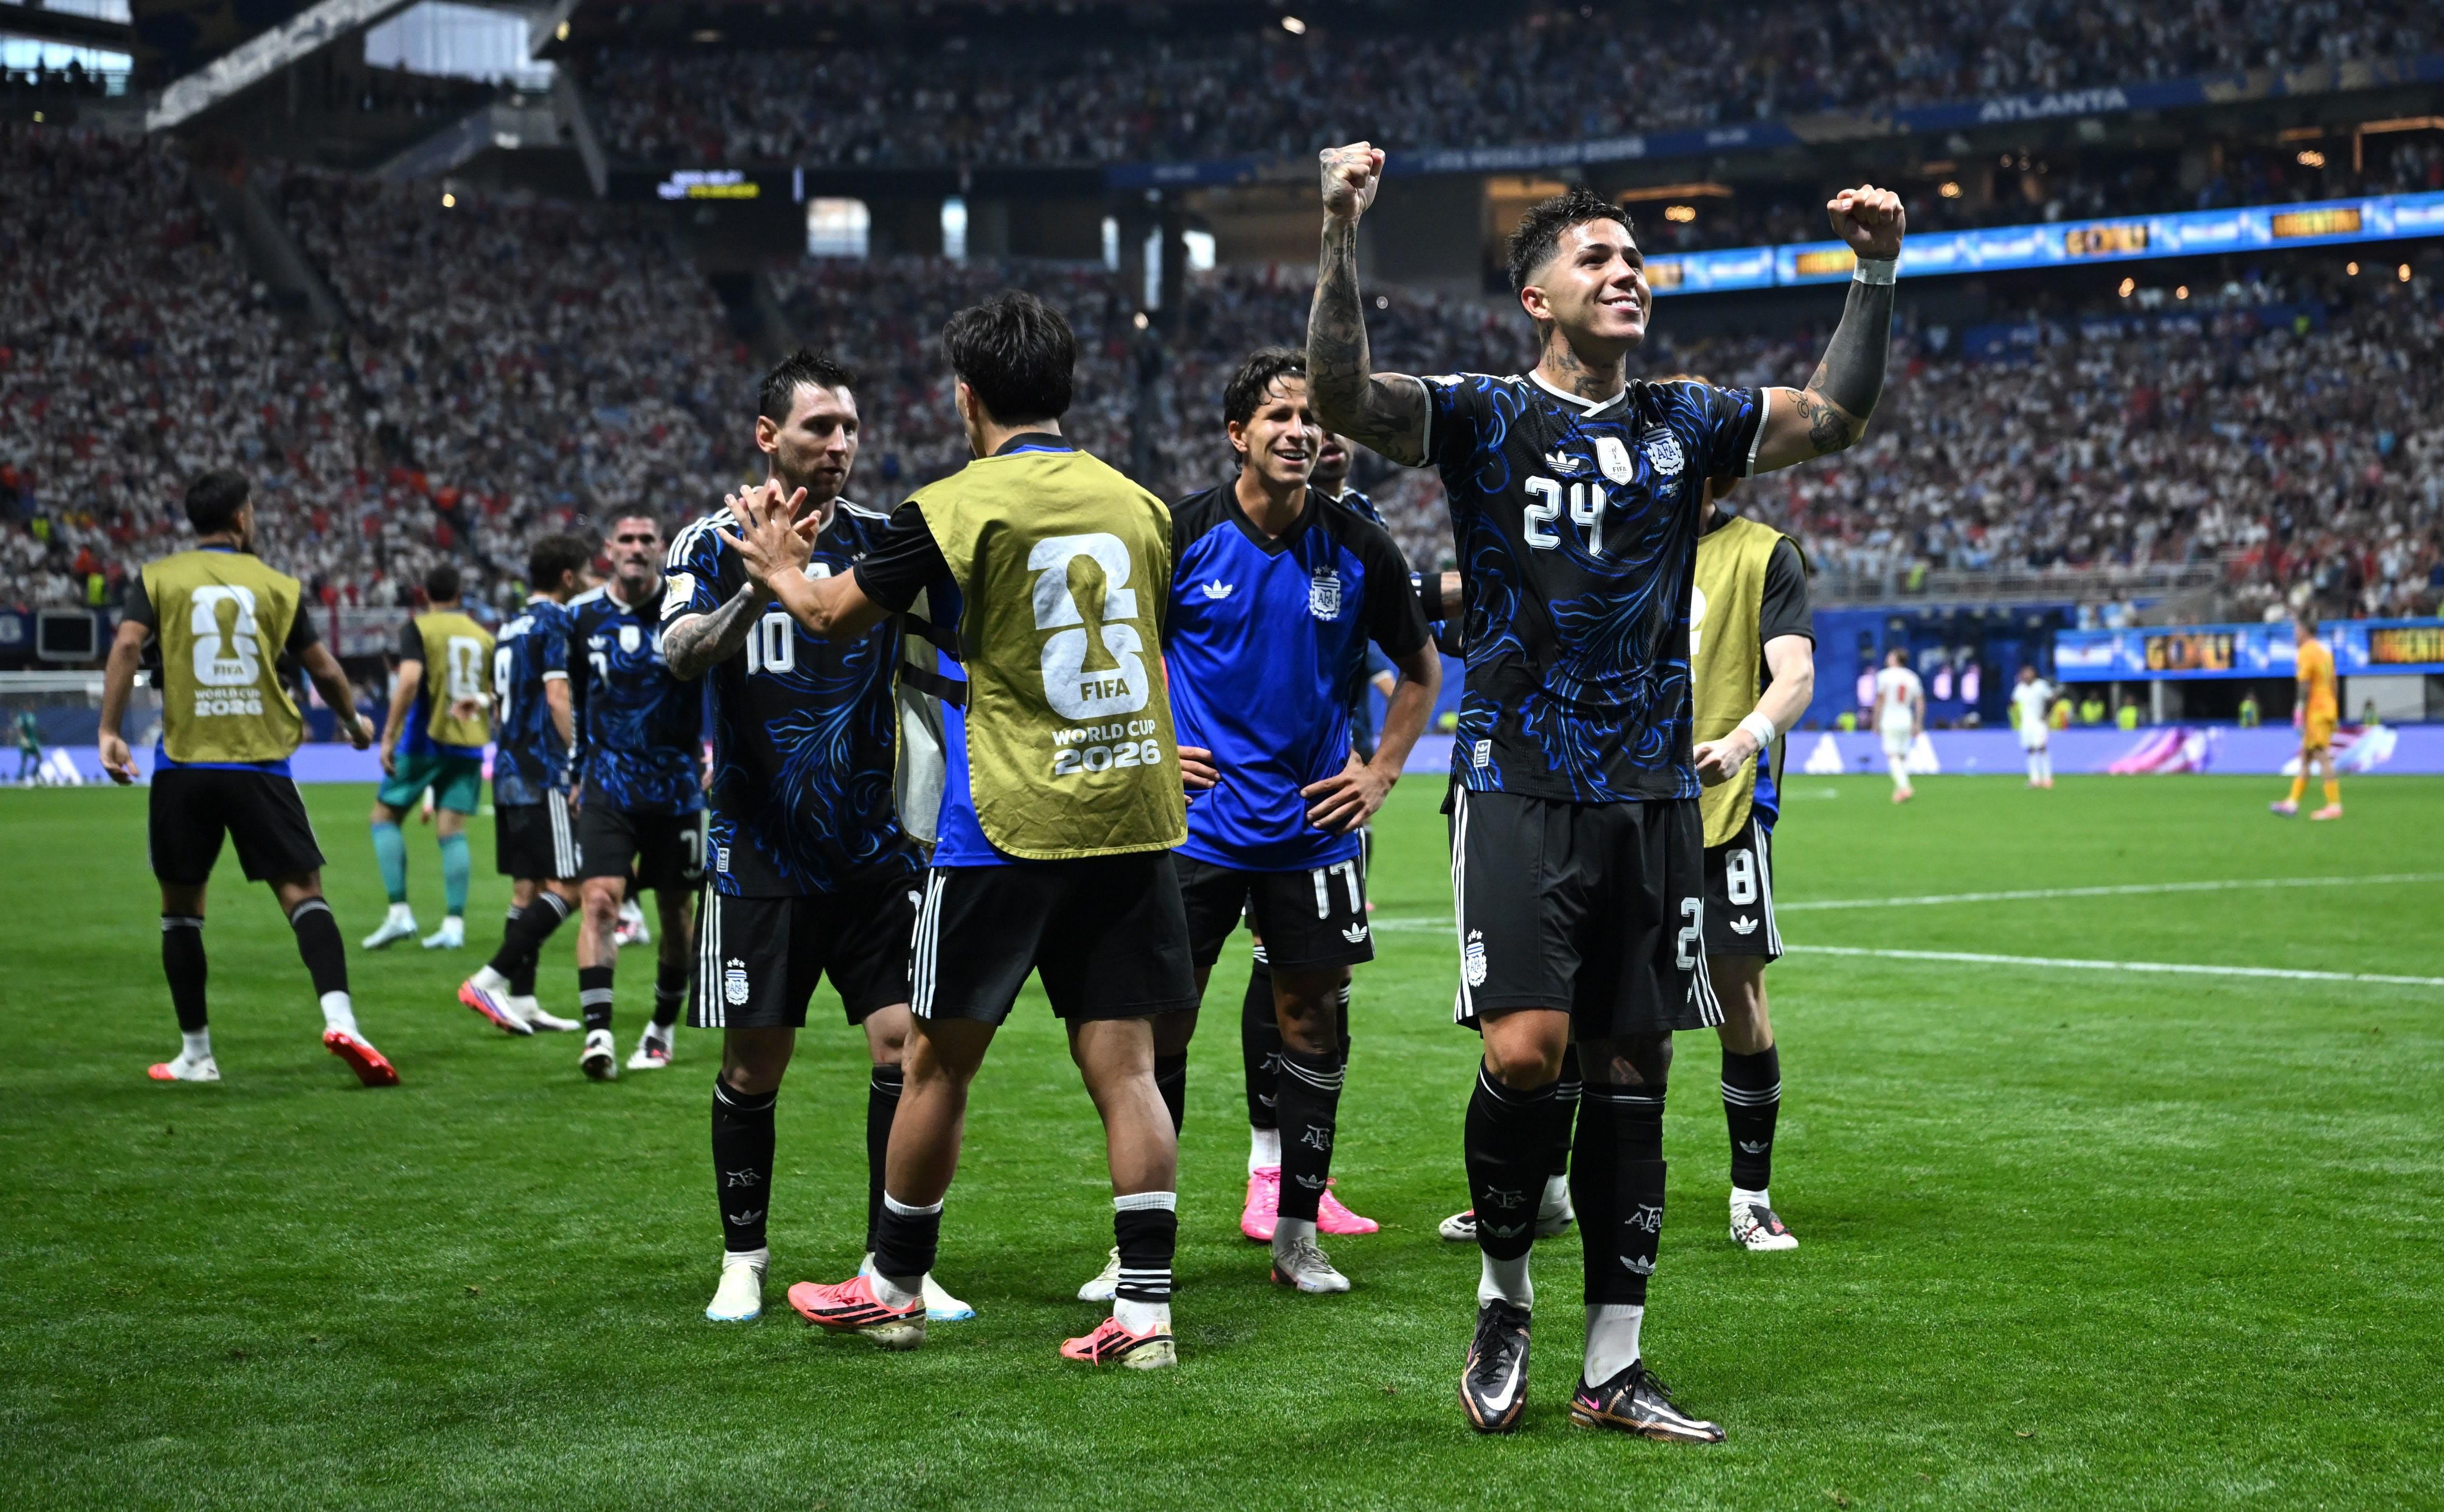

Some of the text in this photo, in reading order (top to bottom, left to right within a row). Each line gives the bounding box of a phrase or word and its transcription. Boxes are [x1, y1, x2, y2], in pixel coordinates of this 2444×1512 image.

[1978, 88, 2127, 122] ATLANTA
[1524, 475, 1606, 556] 24
[747, 612, 794, 675] 10
[214, 664, 243, 675] FIFA
[194, 688, 237, 699] WORLD
[1080, 678, 1131, 701] FIFA
[195, 699, 263, 716] 2026
[1052, 719, 1156, 746] WORLD CUP
[1054, 739, 1161, 775] 2026
[1308, 859, 1361, 919] 17
[1725, 848, 1757, 905] 8
[1625, 1203, 1663, 1234] AFA
